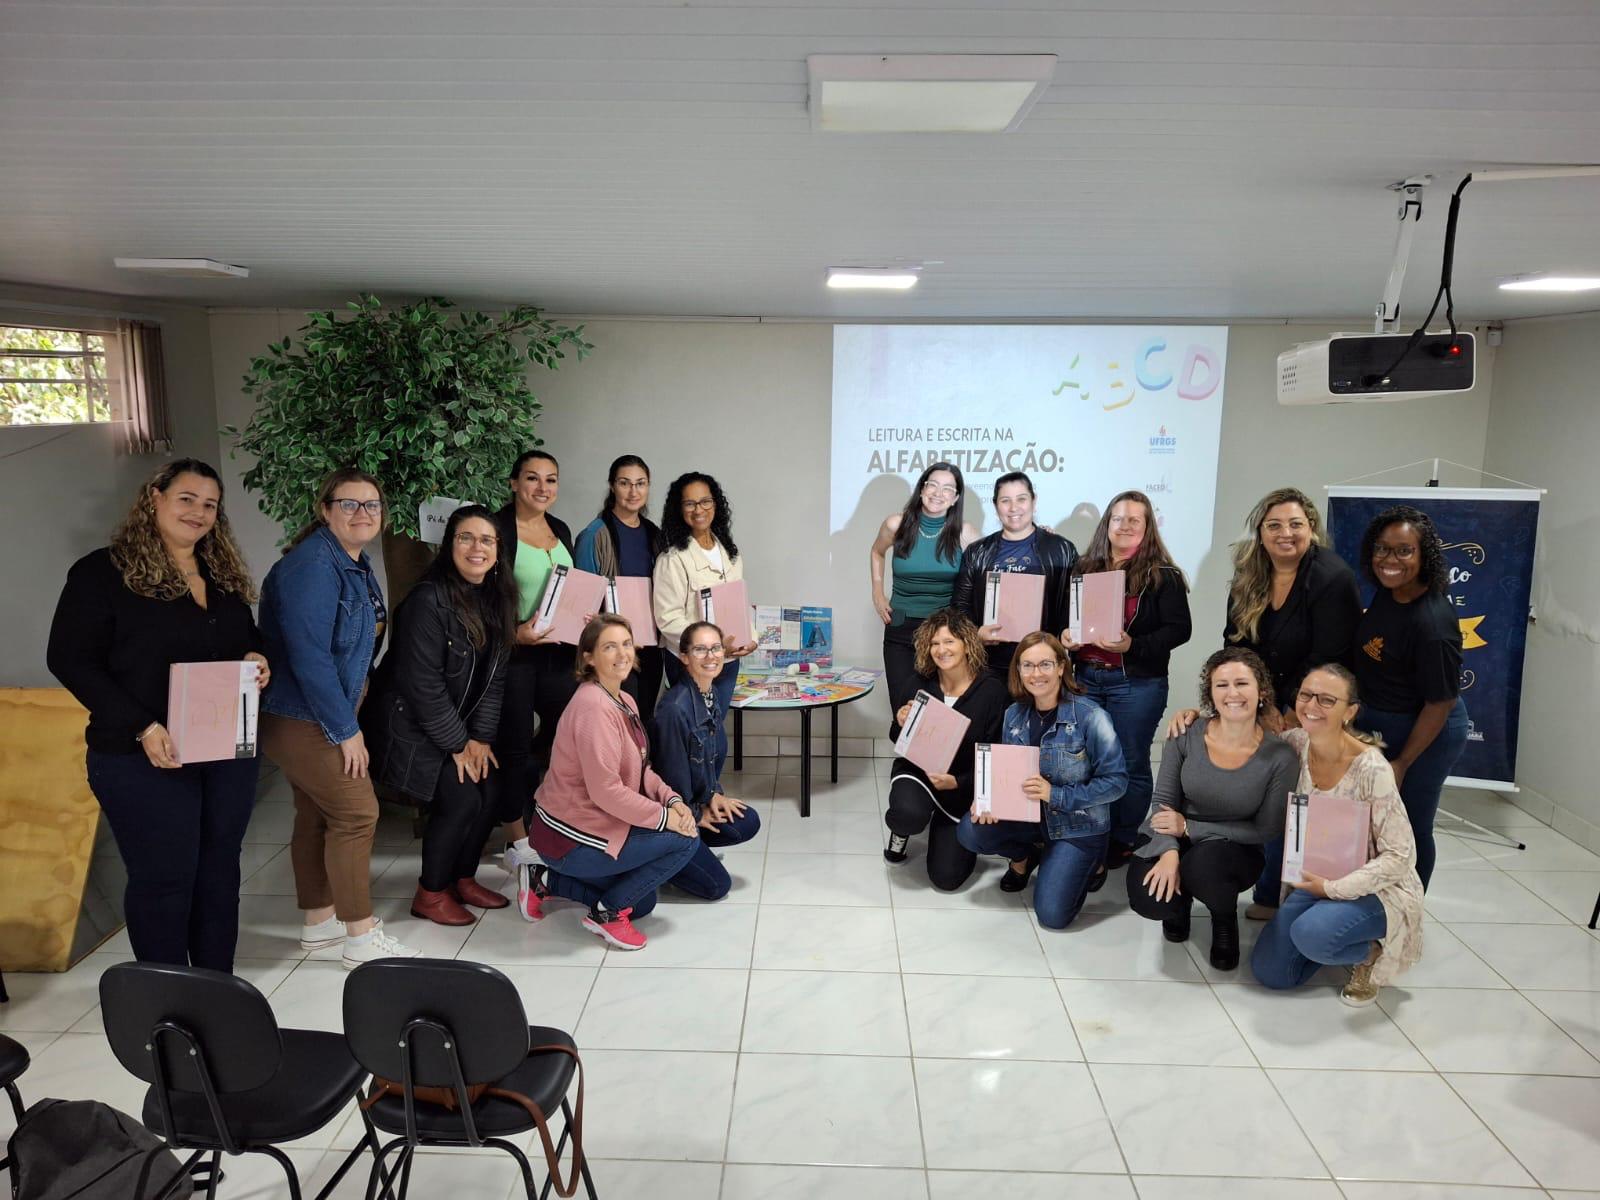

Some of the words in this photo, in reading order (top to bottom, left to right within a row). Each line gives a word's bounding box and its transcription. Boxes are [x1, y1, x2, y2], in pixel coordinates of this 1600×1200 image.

[868, 428, 923, 442] LEITURA
[927, 428, 934, 442] E
[937, 427, 991, 441] ESCRITA
[994, 427, 1014, 441] NA
[1149, 437, 1177, 446] UFRGS
